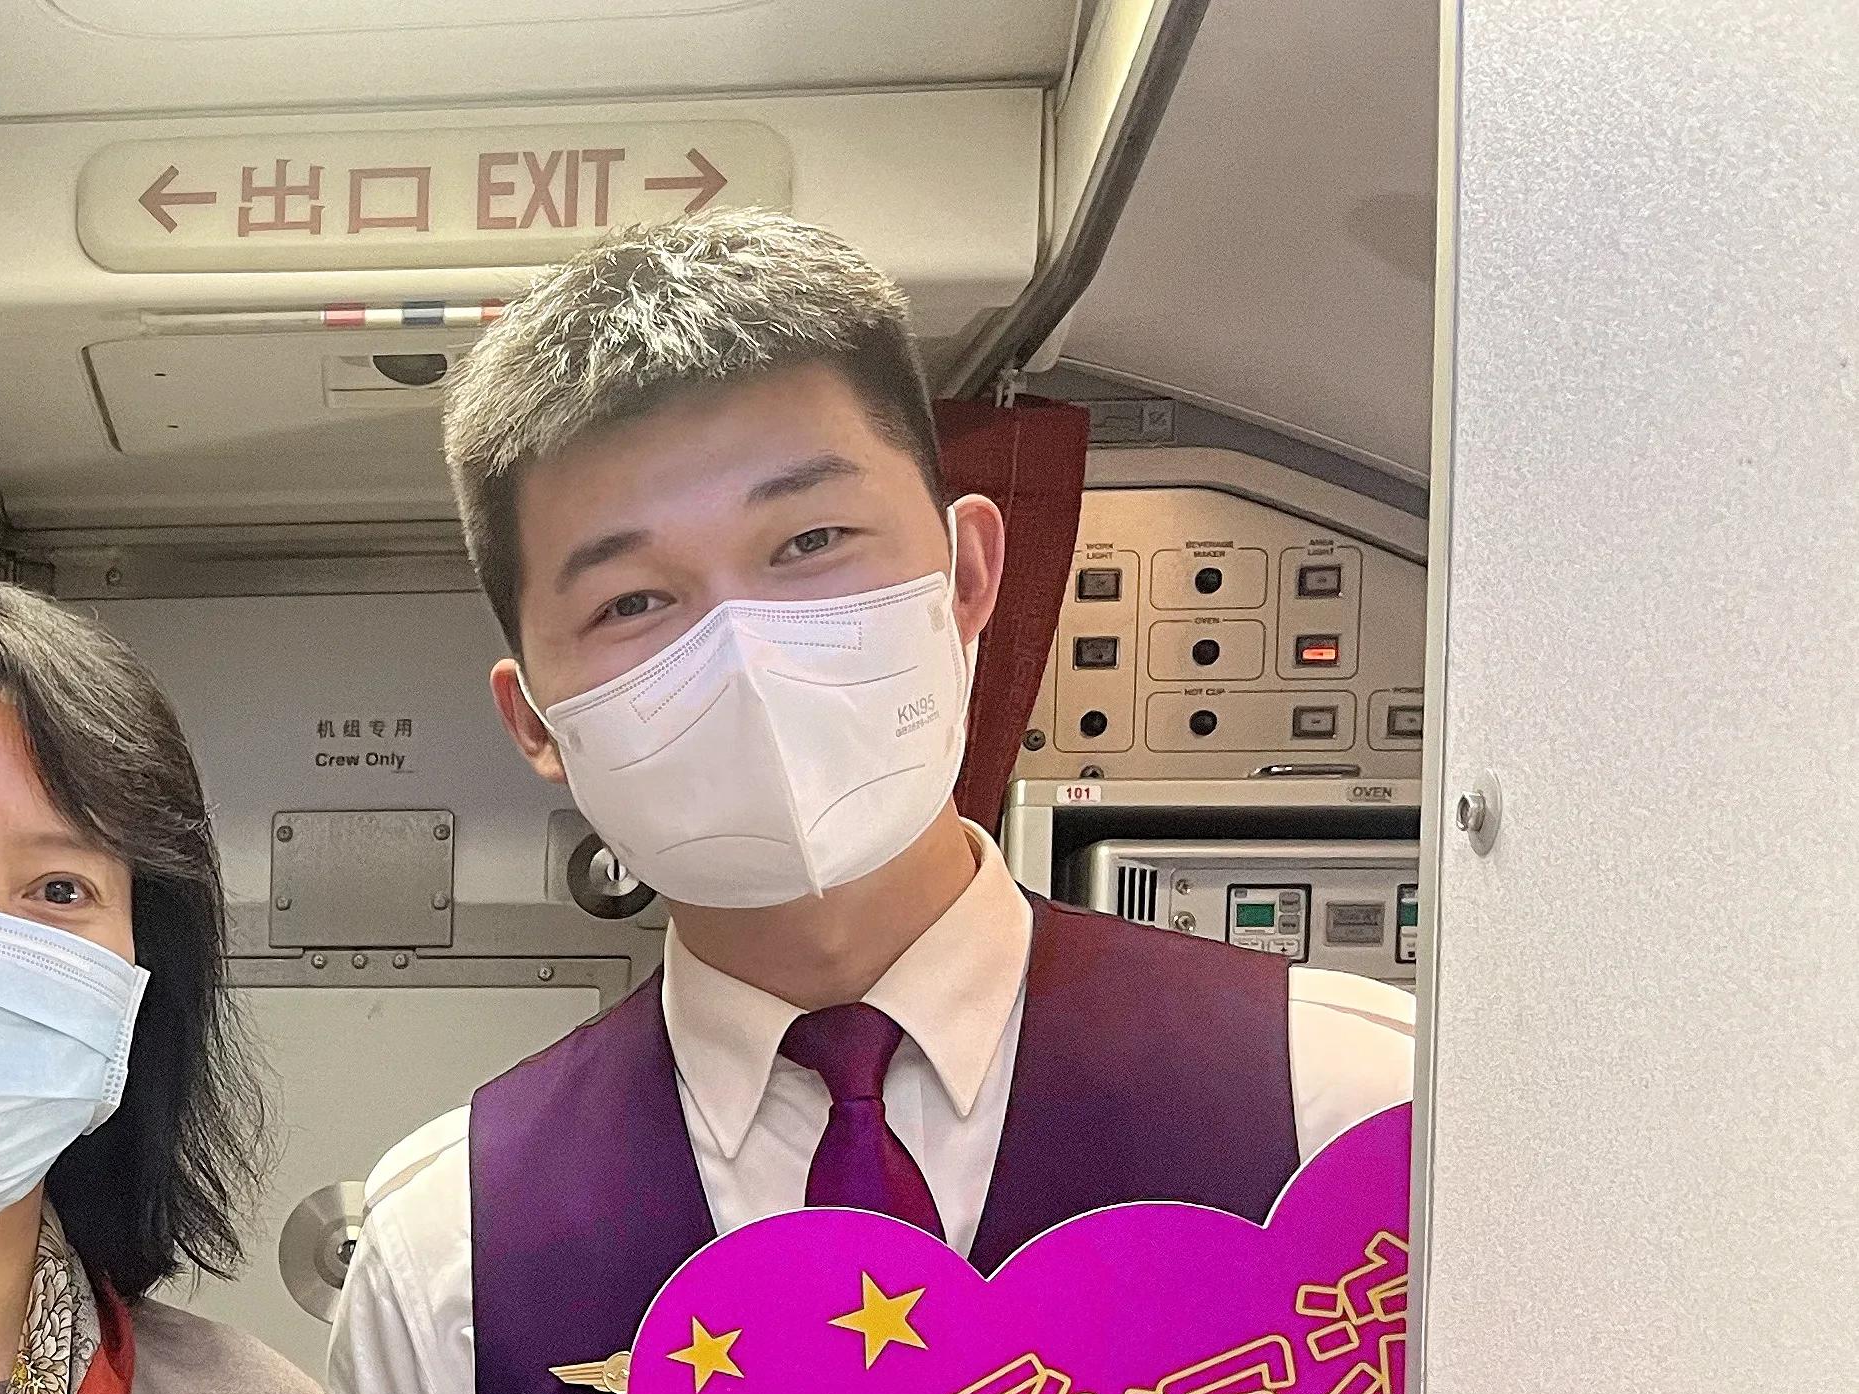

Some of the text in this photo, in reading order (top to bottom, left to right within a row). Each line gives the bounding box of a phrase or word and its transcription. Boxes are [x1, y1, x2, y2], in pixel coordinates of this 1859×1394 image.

[238, 148, 626, 237] 出口 EXIT
[1086, 551, 1114, 560] LIGHT
[1194, 617, 1220, 625] OVEN
[1184, 688, 1226, 696] HOT CUP
[897, 693, 936, 725] KN95
[316, 718, 413, 738] 机组专用
[315, 751, 406, 770] Crew Only
[1066, 787, 1091, 799] 101
[1352, 786, 1393, 799] OVEN
